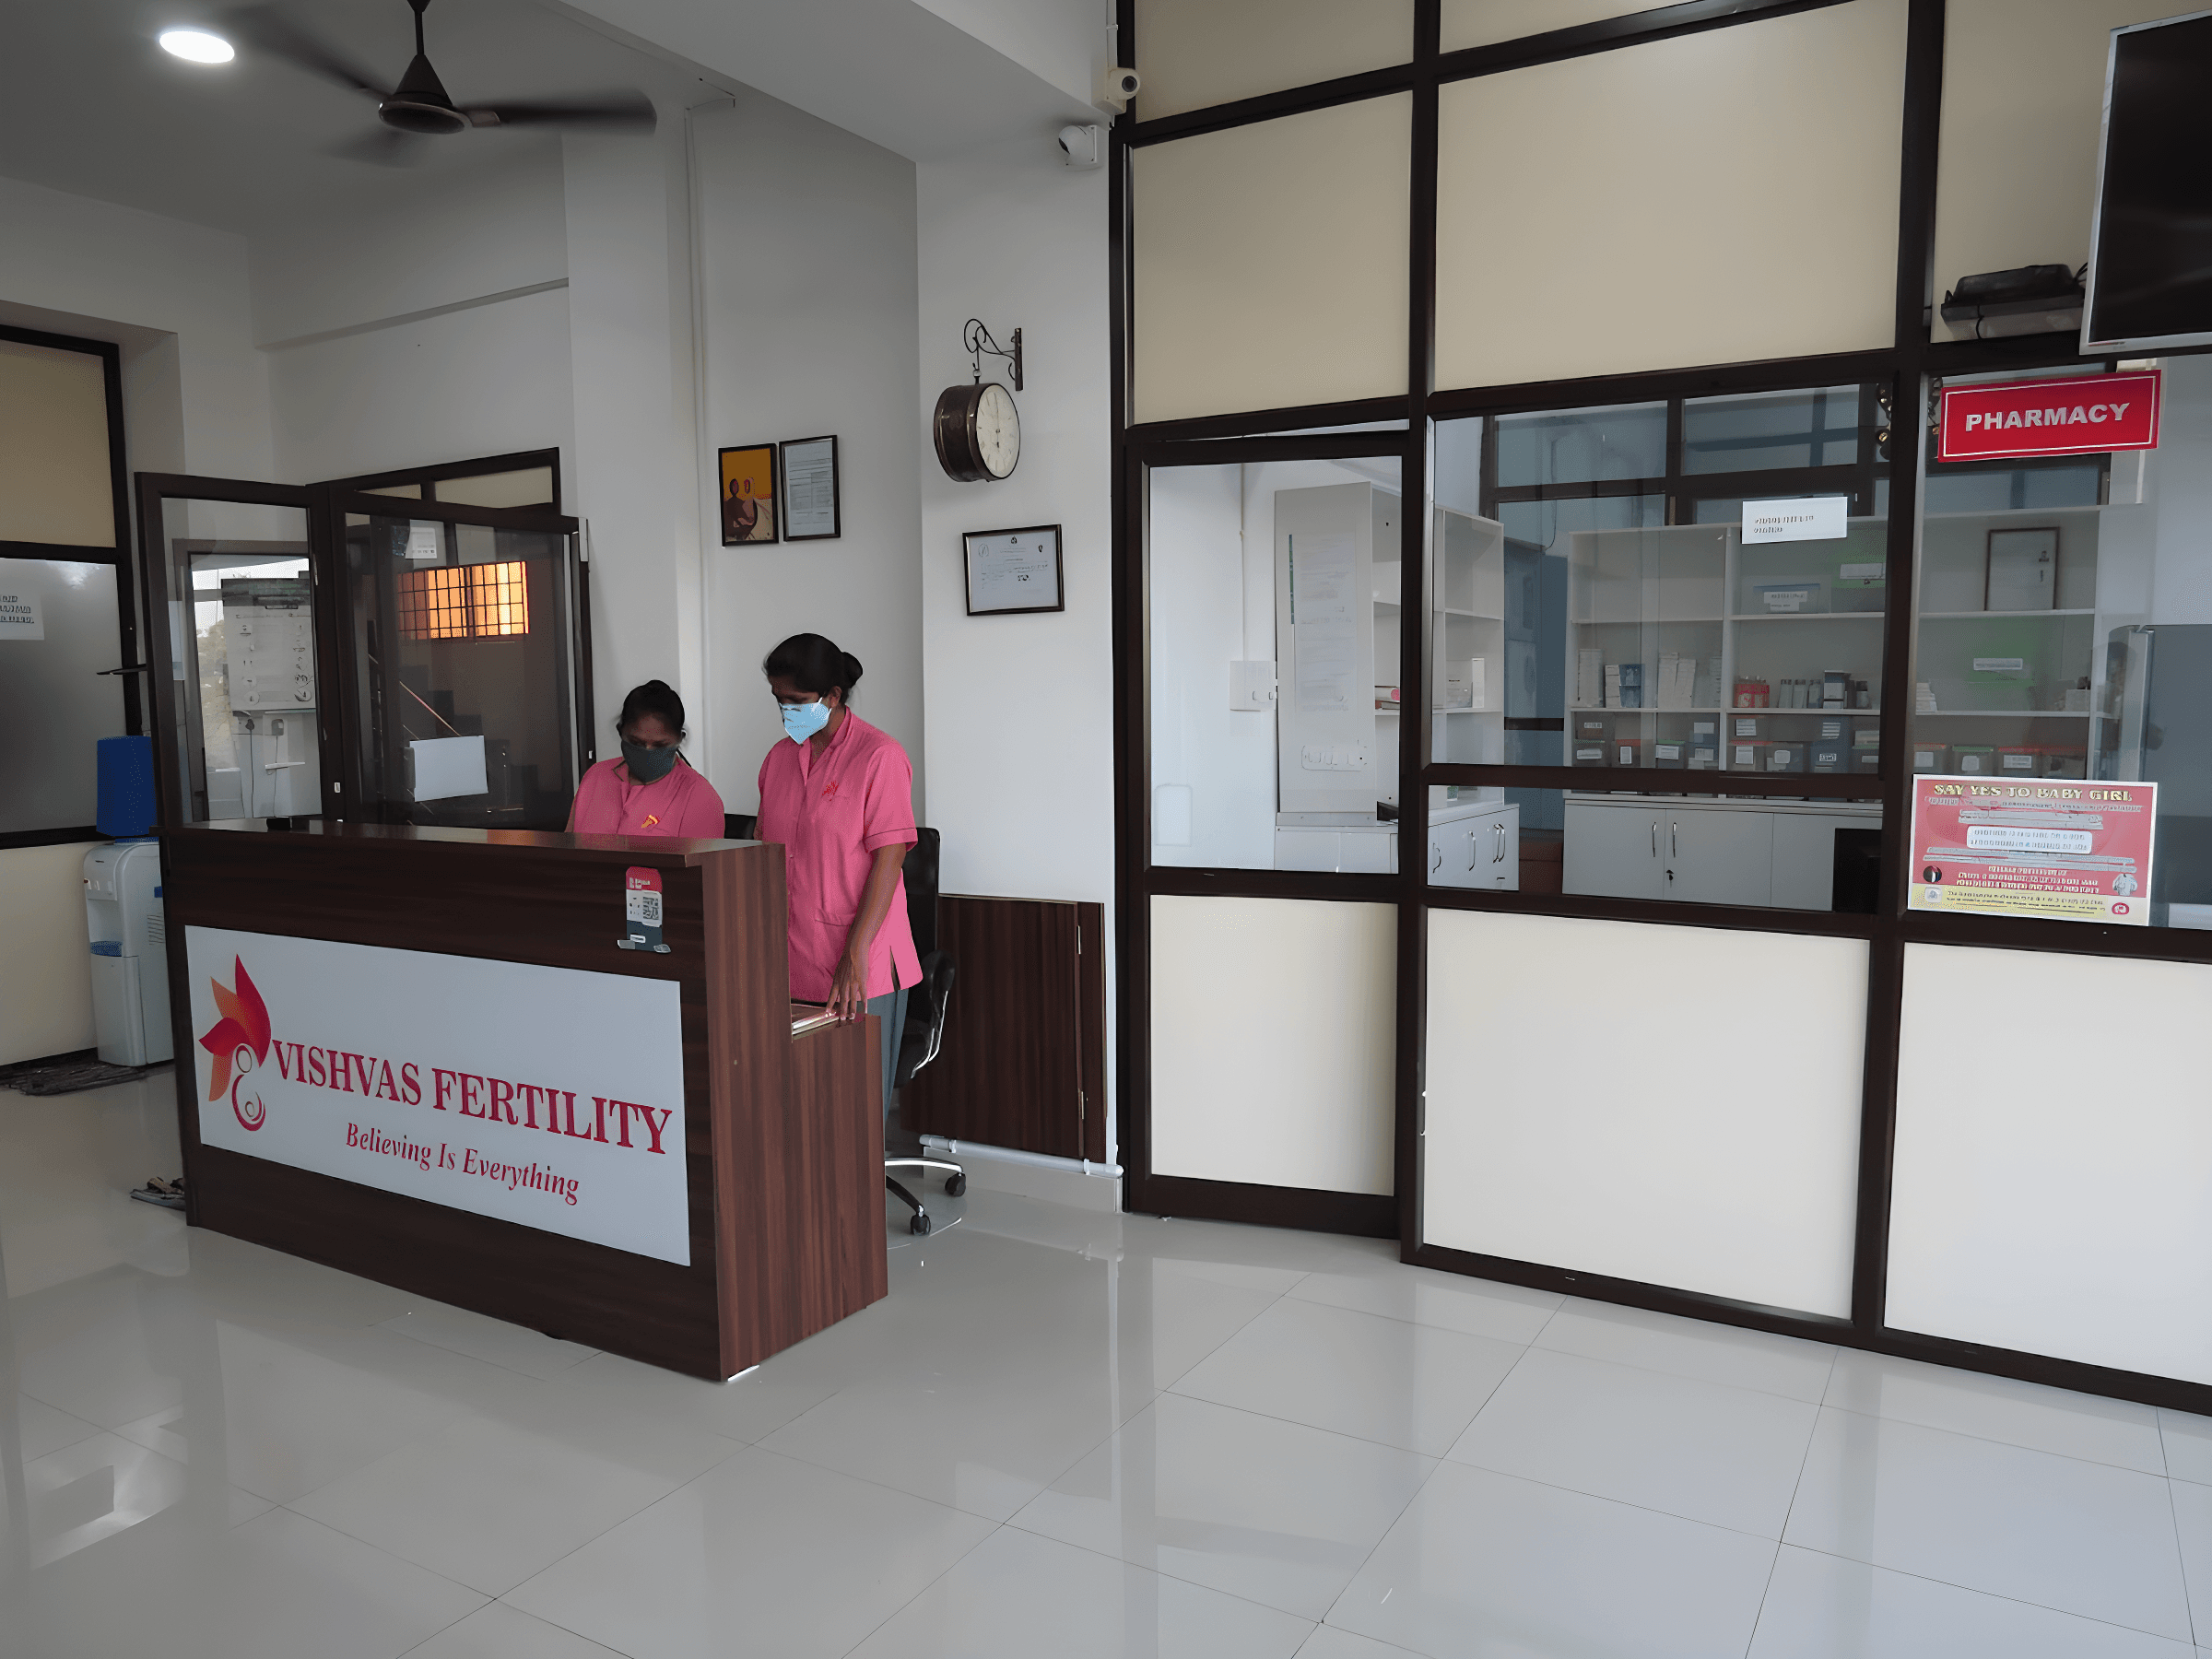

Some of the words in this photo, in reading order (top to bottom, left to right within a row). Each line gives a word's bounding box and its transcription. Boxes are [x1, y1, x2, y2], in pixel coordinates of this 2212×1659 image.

[1965, 403, 2130, 432] PHARMACY
[1934, 784, 1964, 795] SAY
[1970, 785, 2002, 797] YES
[2006, 787, 2031, 798] TO
[2088, 790, 2134, 802] GIRL
[271, 1039, 422, 1106] VISHVAS
[431, 1067, 673, 1155] FERTILITY
[346, 1123, 431, 1171] Believing
[437, 1142, 456, 1171] Is
[462, 1147, 579, 1206] Everything
